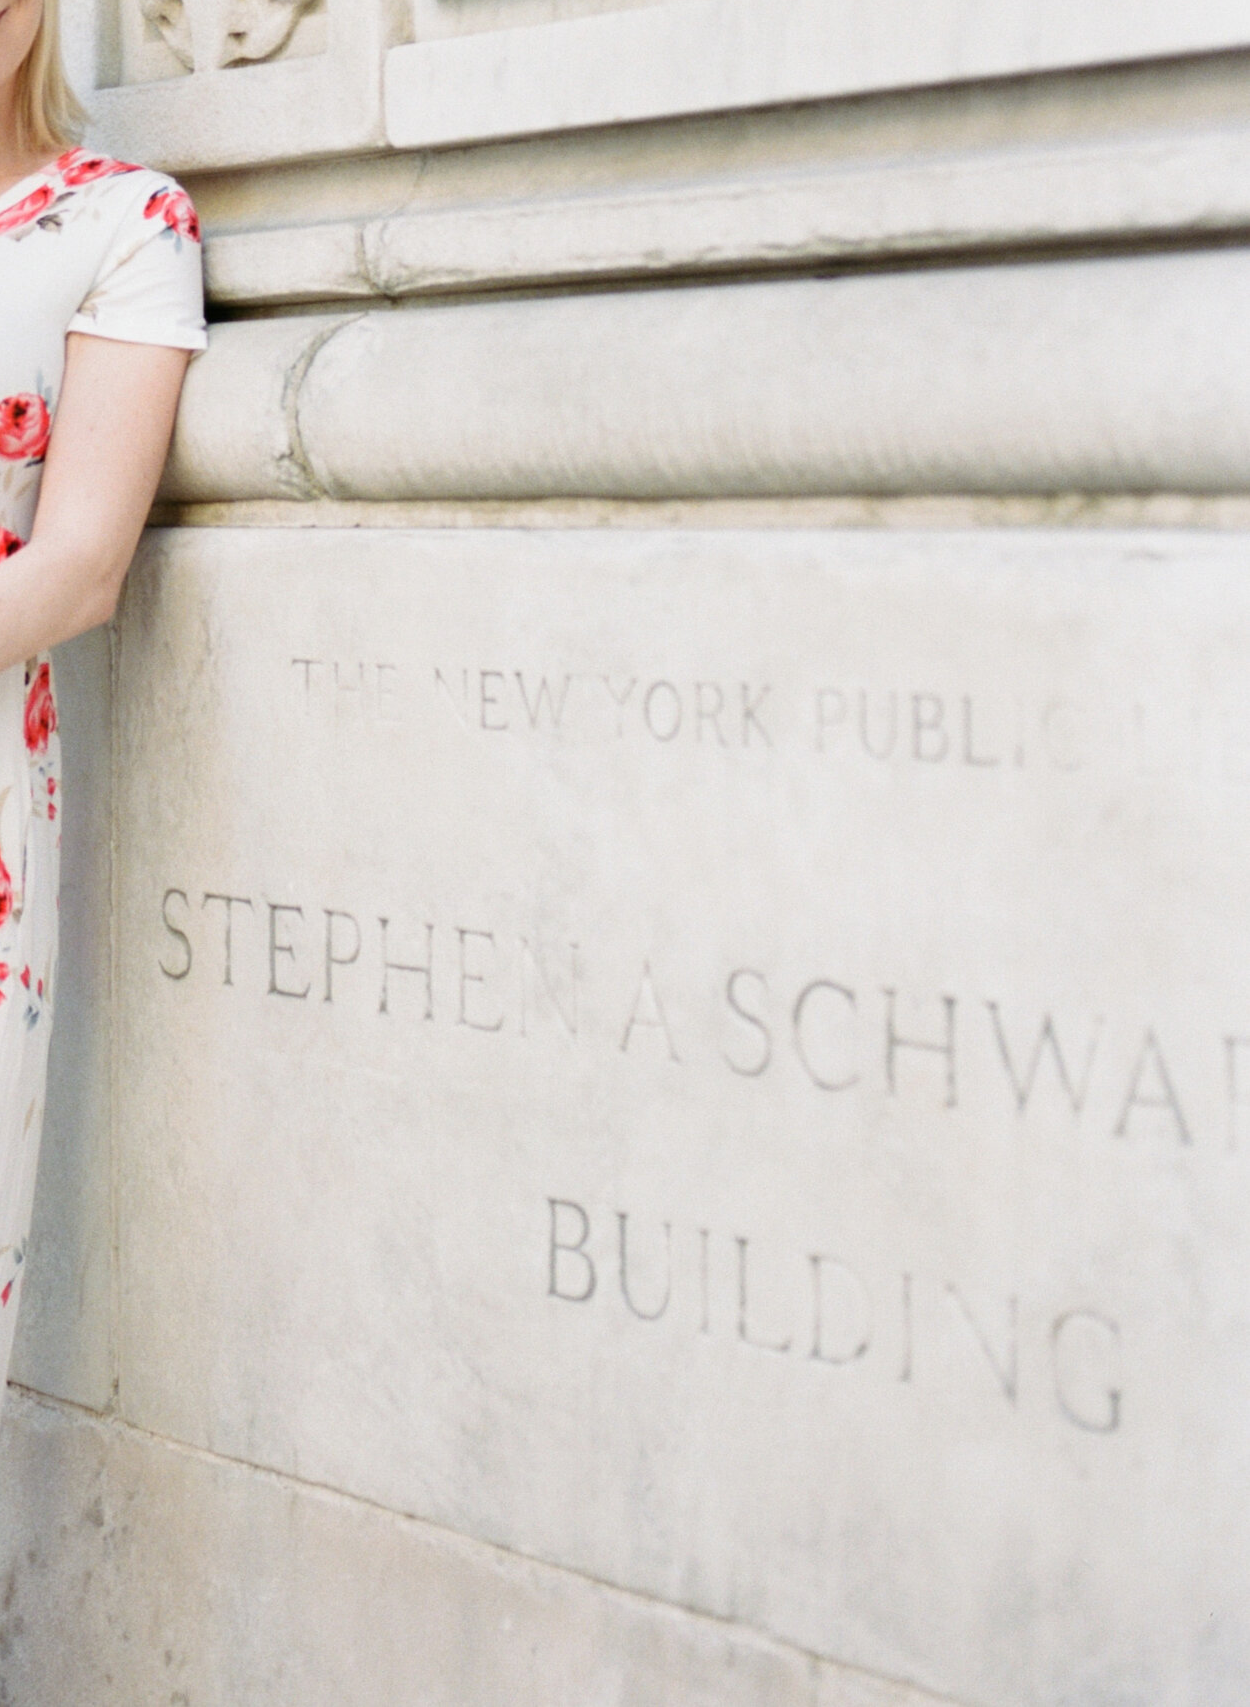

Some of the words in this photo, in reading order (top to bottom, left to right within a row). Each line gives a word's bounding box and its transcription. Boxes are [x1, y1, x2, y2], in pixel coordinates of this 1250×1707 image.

[432, 666, 576, 734] NEW
[600, 676, 777, 751] YORK
[814, 684, 1087, 773] PUBLIC
[158, 885, 582, 1040] STEPHEN
[616, 958, 686, 1065] A
[543, 1192, 1124, 1437] BUILDING
